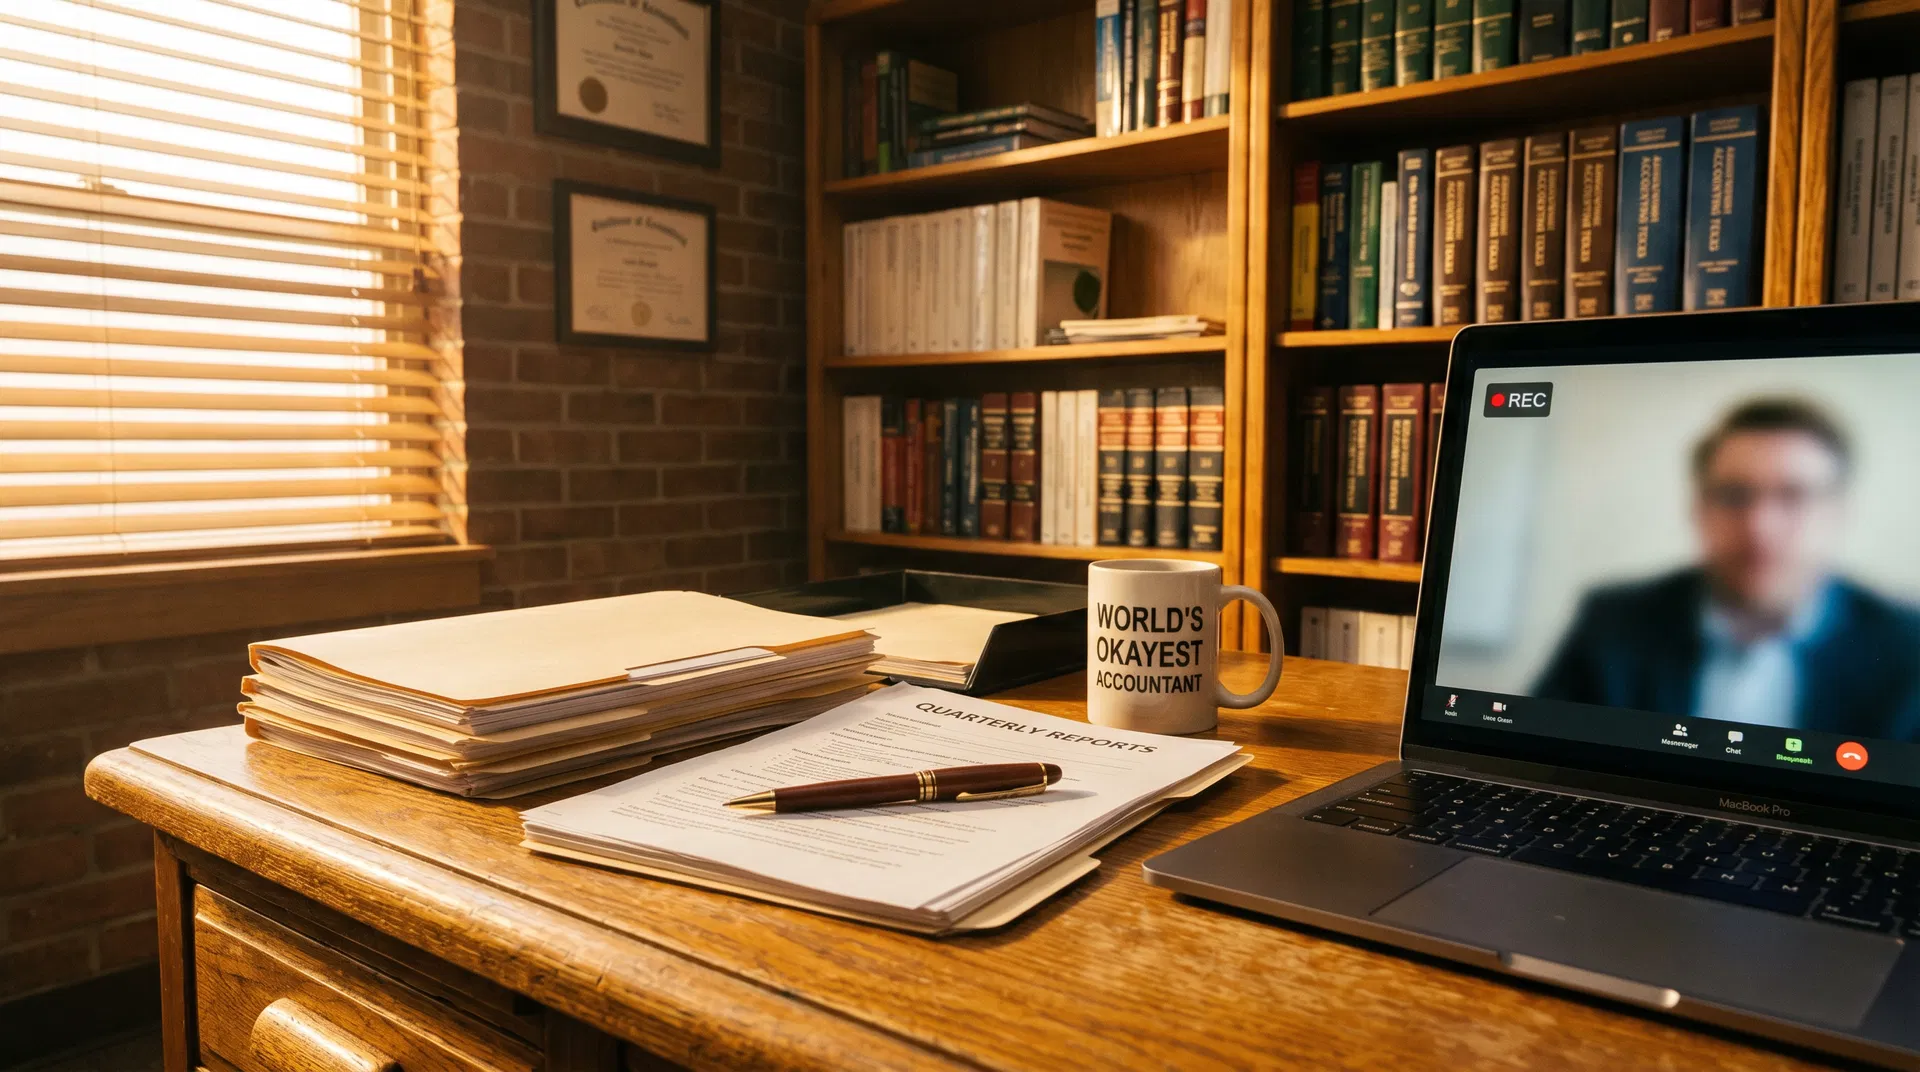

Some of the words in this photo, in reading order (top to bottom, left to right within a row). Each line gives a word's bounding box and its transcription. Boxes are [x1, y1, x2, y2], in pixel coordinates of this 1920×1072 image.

[1508, 392, 1547, 408] REC
[1097, 602, 1203, 633] WORLD'S
[1096, 636, 1203, 668] OKAYEST
[1096, 669, 1202, 694] ACCOUNTANT
[915, 702, 1047, 734] QUARTERLY
[1045, 731, 1159, 753] REPORTS
[1719, 798, 1770, 814] MacBook
[1772, 804, 1791, 817] Pro
